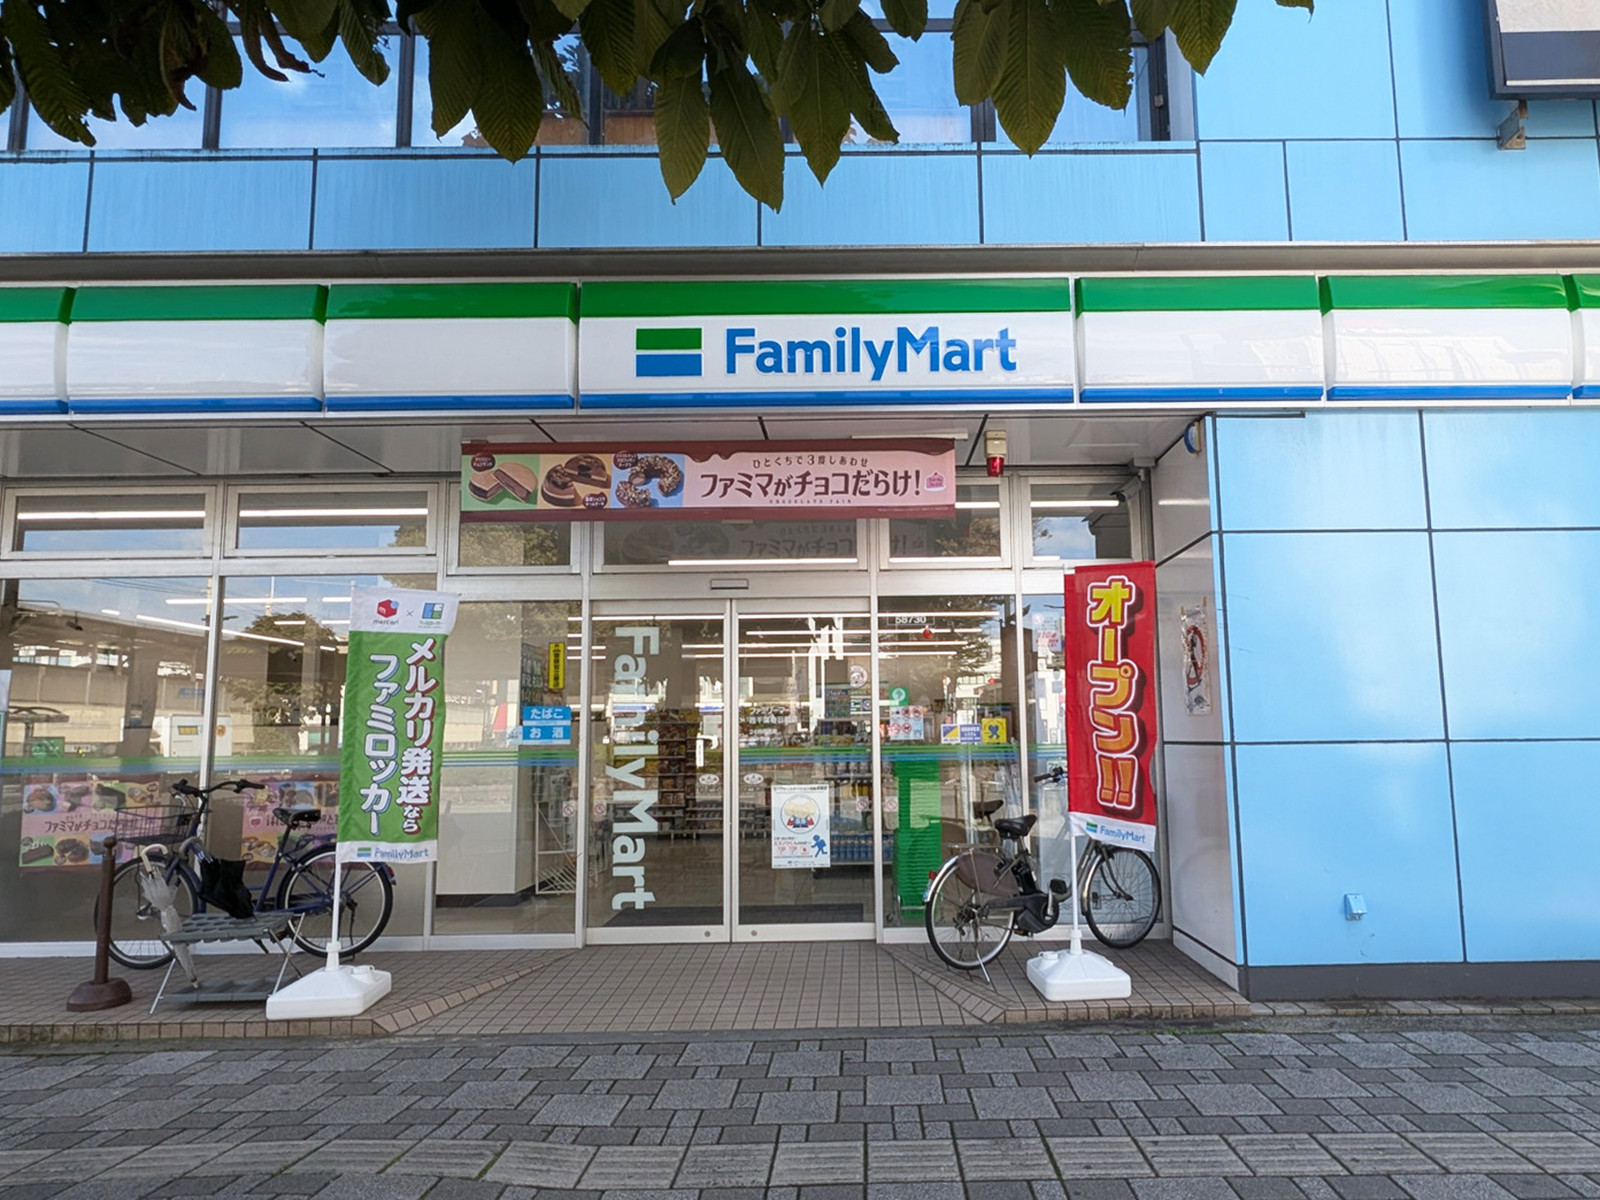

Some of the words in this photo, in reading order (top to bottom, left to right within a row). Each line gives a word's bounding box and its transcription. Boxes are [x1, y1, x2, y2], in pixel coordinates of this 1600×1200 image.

[725, 326, 1017, 381] FamilyMart
[753, 454, 869, 468] ひとくちで3度しあわせ
[700, 470, 921, 498] ファミマがチョコだらけ!
[530, 707, 564, 719] たばこ
[360, 654, 400, 836] ファミロッカー
[396, 637, 438, 834] メルカリ発送なら
[1100, 825, 1146, 844] FamilyMart
[375, 847, 429, 859] FamilyMart
